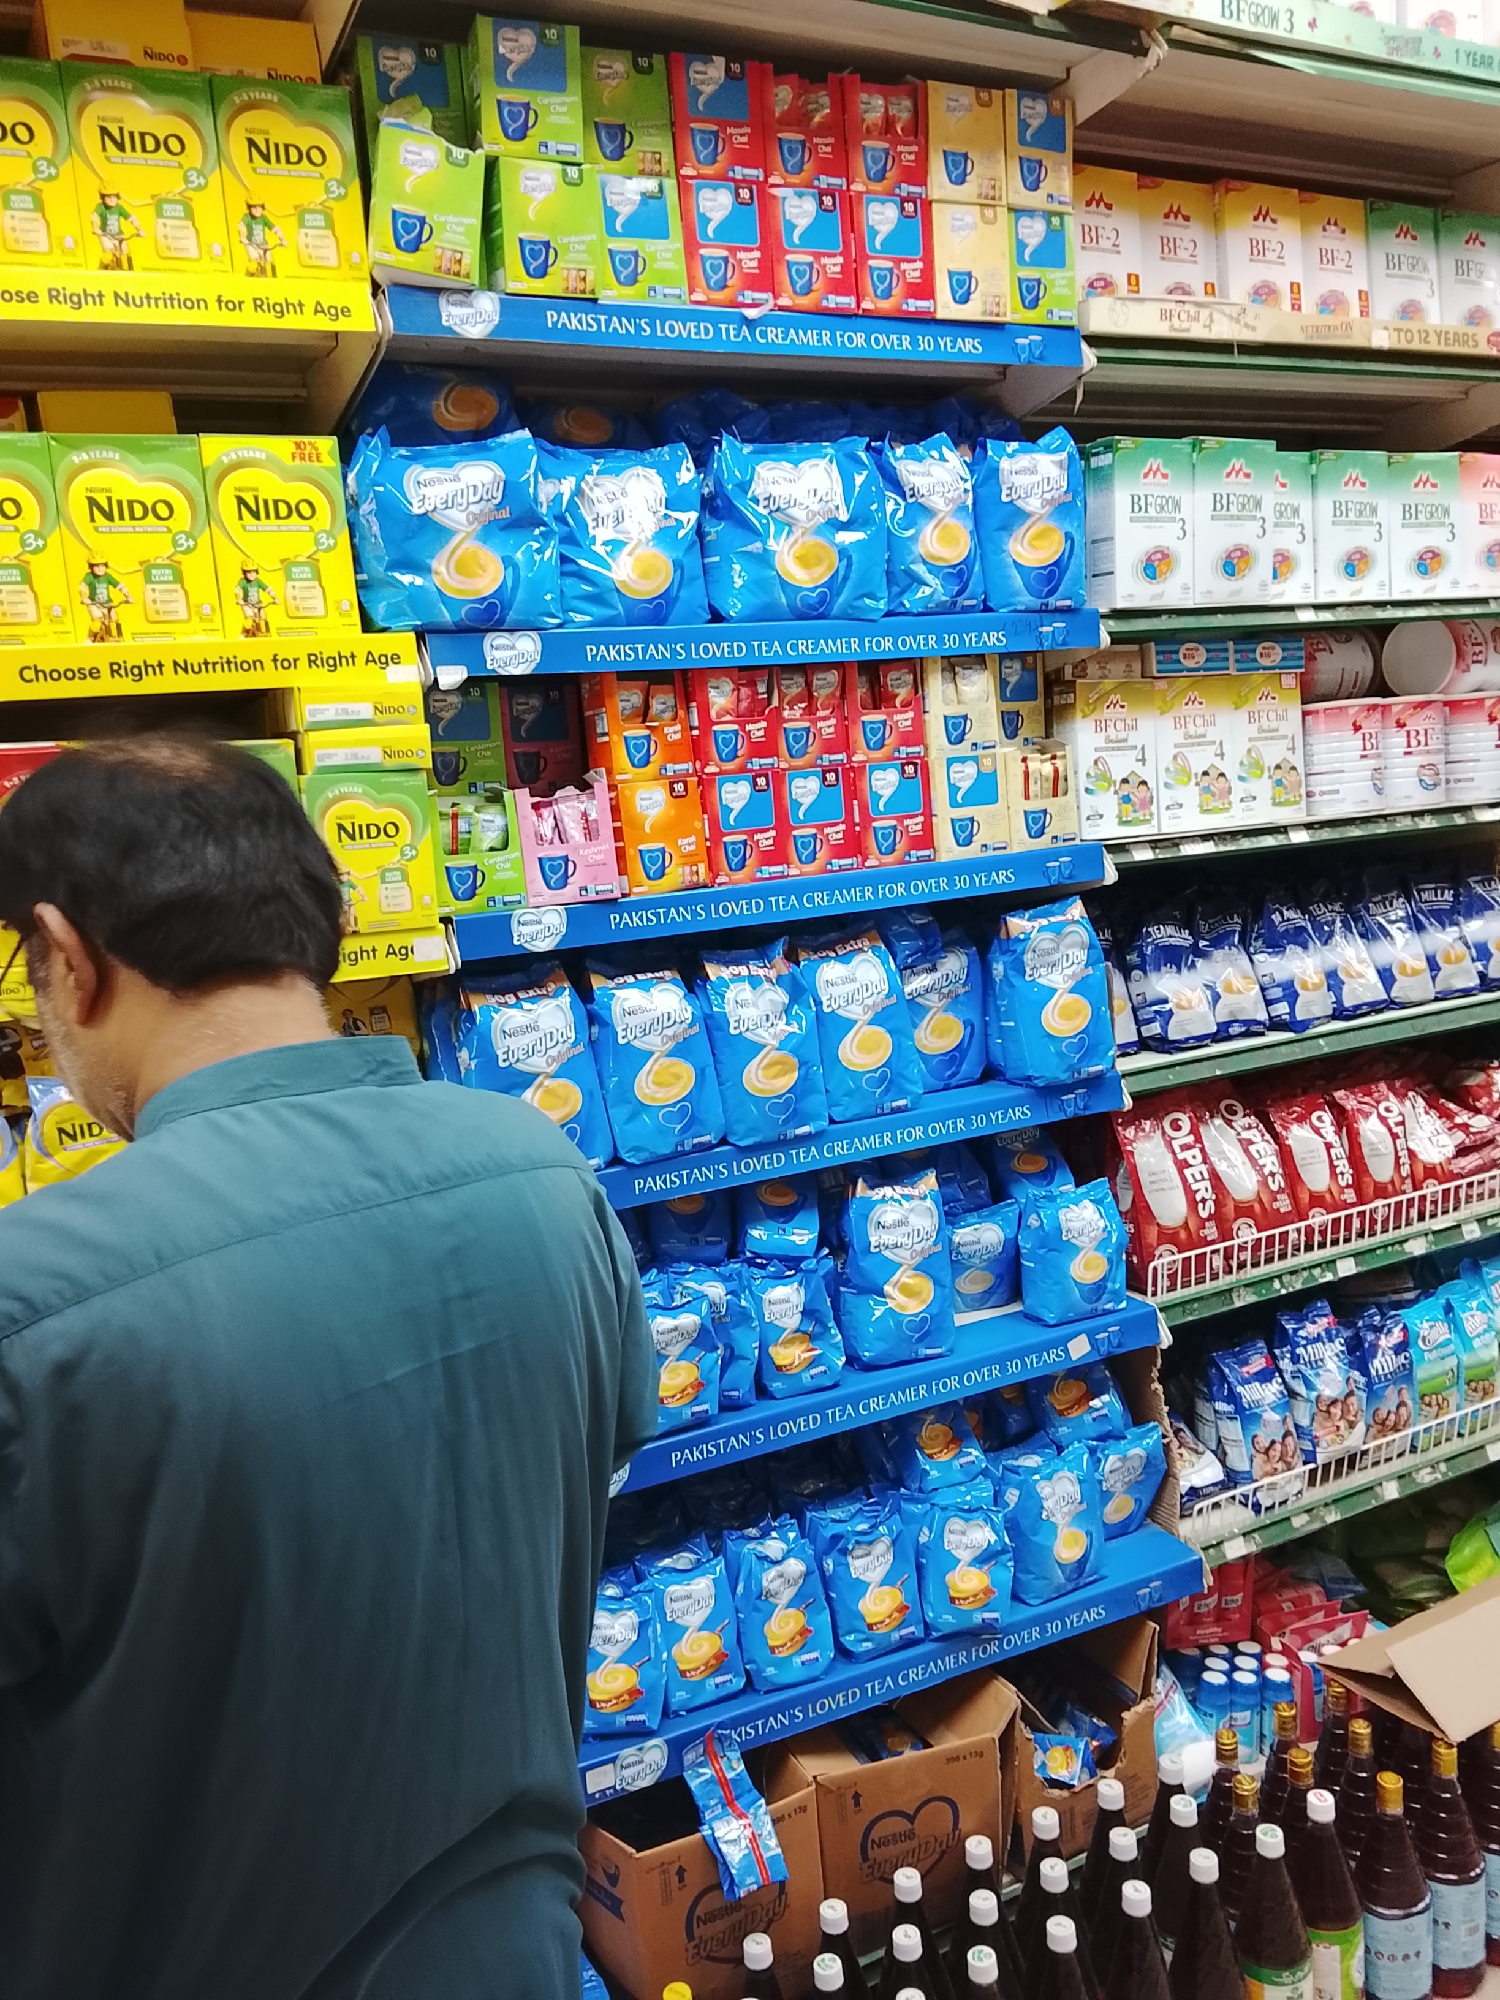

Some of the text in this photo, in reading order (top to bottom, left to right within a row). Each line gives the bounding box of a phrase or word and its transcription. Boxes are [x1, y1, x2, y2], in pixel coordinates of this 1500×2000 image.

[1284, 9, 1294, 33] 3
[545, 29, 556, 40] 10
[143, 48, 175, 63] NIDO
[1463, 51, 1493, 67] YEAR
[730, 63, 741, 73] 10
[550, 104, 568, 112] Chai
[98, 124, 186, 156] NIDO
[732, 135, 748, 143] Chai
[245, 137, 327, 167] NIDO
[187, 171, 206, 189] 3+
[738, 188, 749, 199] 10
[822, 195, 833, 206] 10
[903, 202, 914, 213] 10
[447, 223, 464, 232] Chai
[1081, 223, 1121, 247] BF-2
[1159, 235, 1198, 260] BF-2
[1249, 237, 1286, 261] BF-2
[1319, 247, 1353, 269] BF-2
[743, 259, 758, 268] Chai
[1426, 279, 1435, 298] 3
[0, 287, 352, 320] ose Right Nutrition for Right Age
[547, 310, 983, 355] PAKISTAN'S LOVED TEA CREAMER FOR OVER 30 YEARS
[1393, 327, 1479, 348] TO 12 YEARS
[291, 440, 323, 464] 10% FREE
[411, 479, 504, 514] EveryDay
[1001, 473, 1068, 501] EveryDay
[89, 495, 174, 524] NIDO
[237, 493, 317, 521] NIDO
[466, 506, 510, 526] Original
[1176, 517, 1187, 541] 3
[1257, 516, 1266, 539] 3
[1374, 522, 1382, 542] 3
[1446, 522, 1455, 542] 3
[175, 534, 195, 550] 3+
[586, 631, 1006, 662] PAKISTAN'S LOVED TEA CREAMER FOR OVER 30 YEARS
[18, 651, 402, 684] Choose Right Nutrition for Right Age
[485, 648, 541, 669] EveryDay
[374, 703, 405, 717] NIDO
[666, 732, 682, 741] Chai
[751, 729, 766, 739] Chai
[1286, 734, 1296, 755] 4
[1135, 744, 1147, 767] 4
[1214, 740, 1225, 762] 4
[672, 782, 685, 792] 10
[336, 822, 400, 843] NIDO
[401, 846, 417, 859] 3+
[587, 853, 604, 863] Chai
[495, 861, 511, 870] Chai
[609, 869, 1015, 929] PAKISTAN'S LOVED TEA CREAMER FOR OVER 30 YEARS
[513, 921, 566, 945] EveryDay
[338, 943, 380, 966] ight
[1025, 947, 1088, 980] EveryDay
[822, 976, 889, 1012] EveryDay
[617, 1005, 692, 1044] EveryDay
[498, 1024, 576, 1068] EveryDay
[635, 1105, 1031, 1194] PAKISTAN'S LOVED TEA CREAMER FOR OVER 30 YEARS
[1163, 1111, 1215, 1219] OLPER'S
[869, 1224, 937, 1252] EveryDay
[672, 1346, 1065, 1467] PAKISTAN'S LOVED TEA CREAMER FOR OVER 30 YEARS
[730, 1604, 1106, 1741] KISTAN'S LOVED TEA CREAMER FOR OVER 30 YEARS
[616, 1761, 667, 1790] EveryDay
[871, 1829, 916, 1850] Nestlé
[860, 1828, 961, 1883] EveryDay
